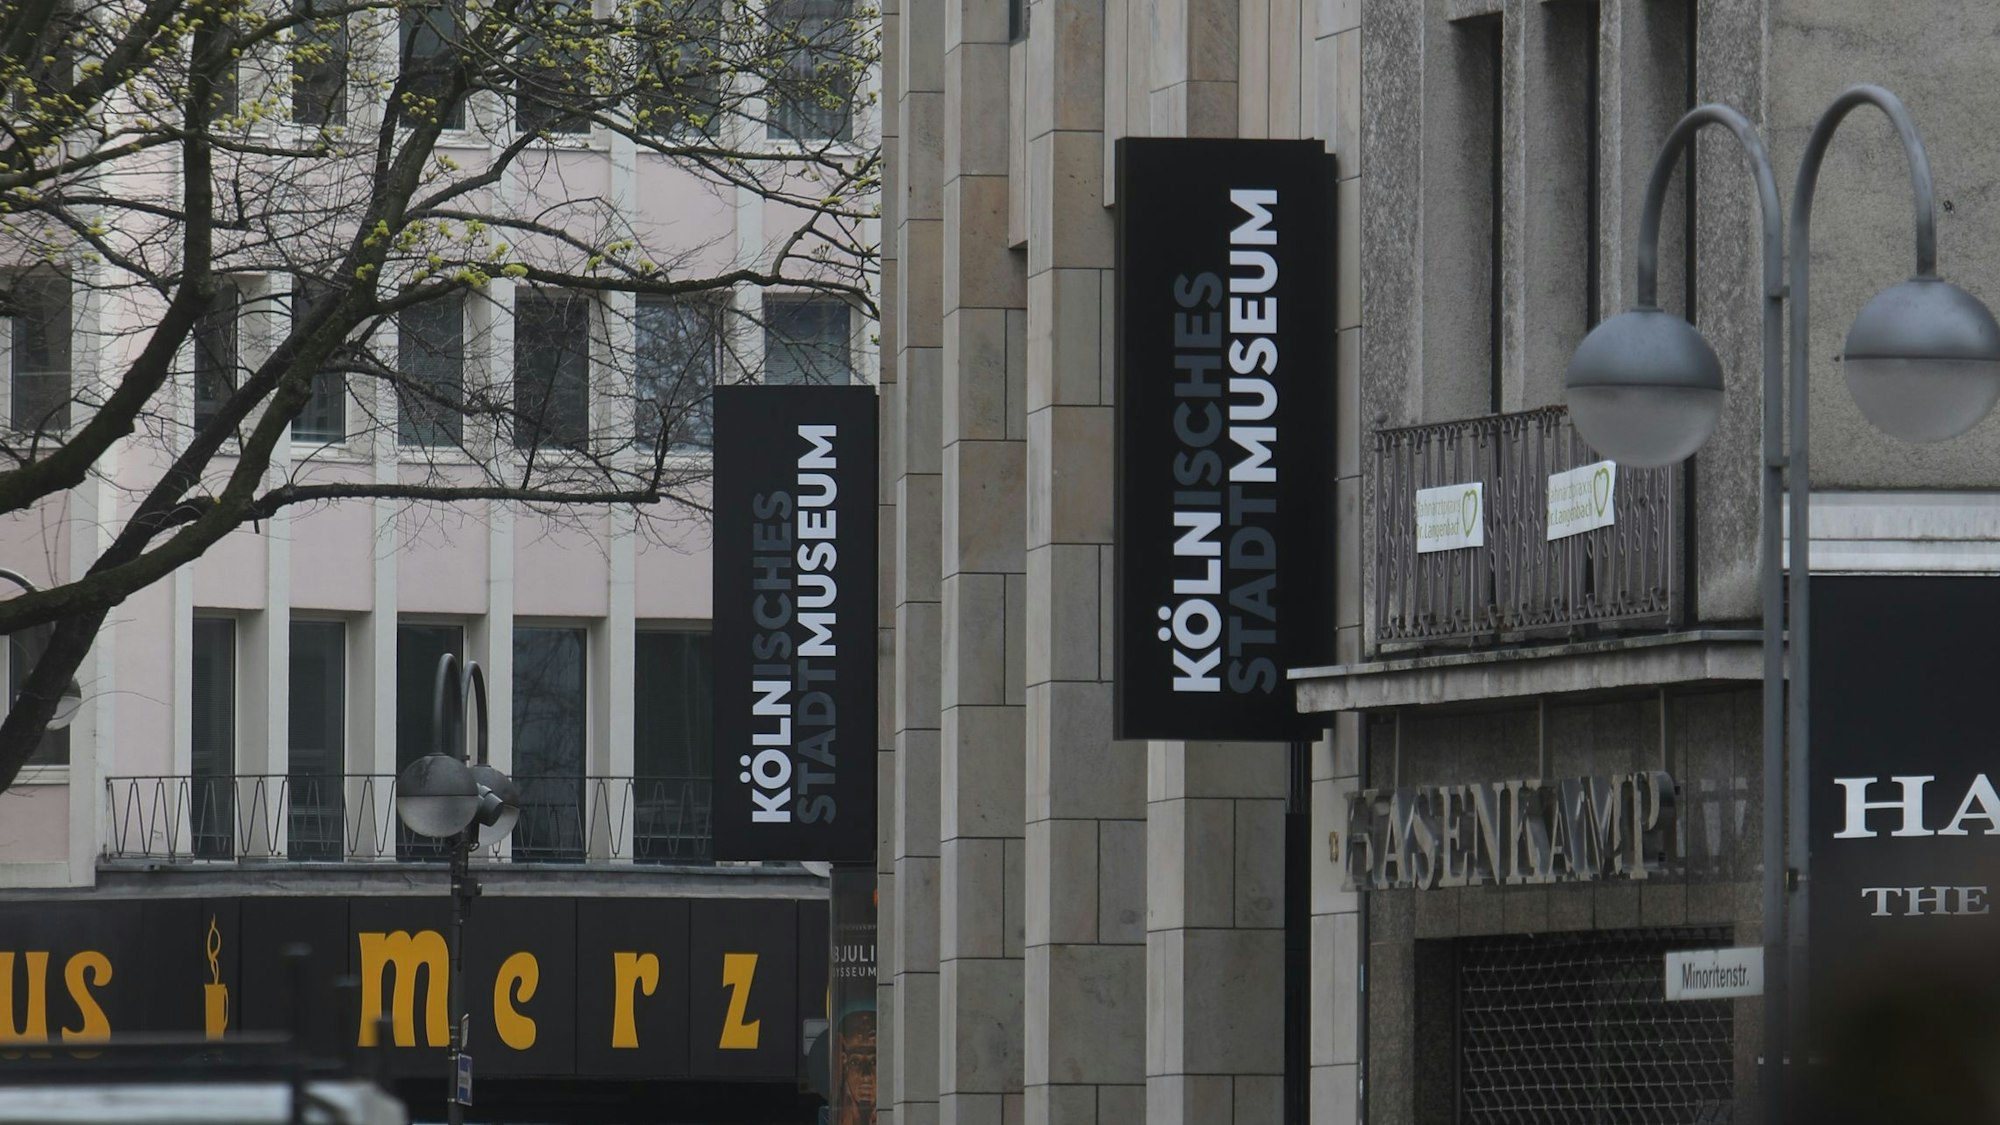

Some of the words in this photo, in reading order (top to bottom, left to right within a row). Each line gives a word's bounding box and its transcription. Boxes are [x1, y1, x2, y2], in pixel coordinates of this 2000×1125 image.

[1157, 272, 1222, 693] KÖLNISCHES
[1228, 188, 1279, 694] STADTMUSEUM
[739, 490, 793, 823] KÖLNISCHES
[797, 424, 837, 825] STADTMUSEUM
[1833, 773, 2000, 839] HA
[1861, 886, 1990, 916] THE
[1682, 962, 1750, 990] Minoritenstr.
